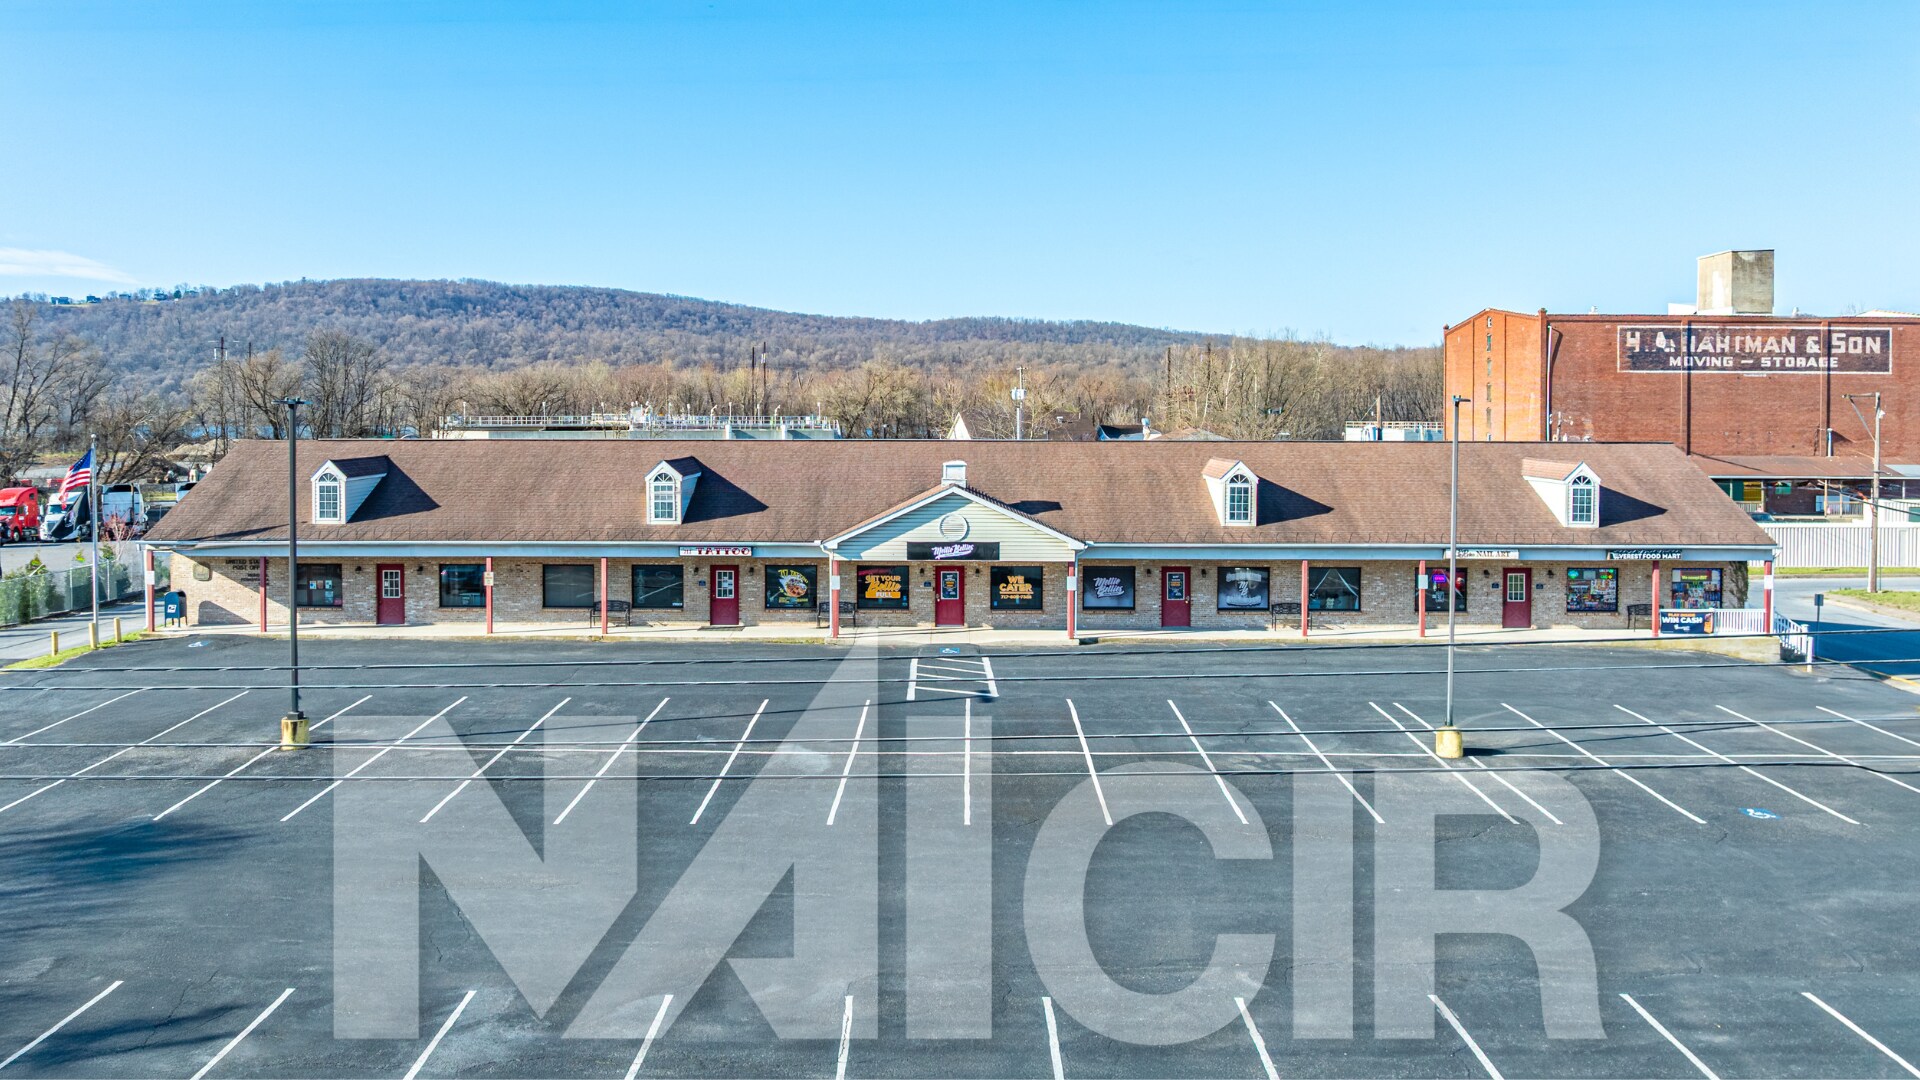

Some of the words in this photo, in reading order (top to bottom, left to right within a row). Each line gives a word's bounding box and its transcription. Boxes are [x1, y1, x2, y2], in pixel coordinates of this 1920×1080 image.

[1806, 336, 1821, 354] &
[1669, 356, 1733, 367] MOVING
[1760, 356, 1839, 368] STORAGE
[696, 547, 750, 555] TATTOO
[1007, 575, 1024, 583] WE
[999, 583, 1032, 592] CATER
